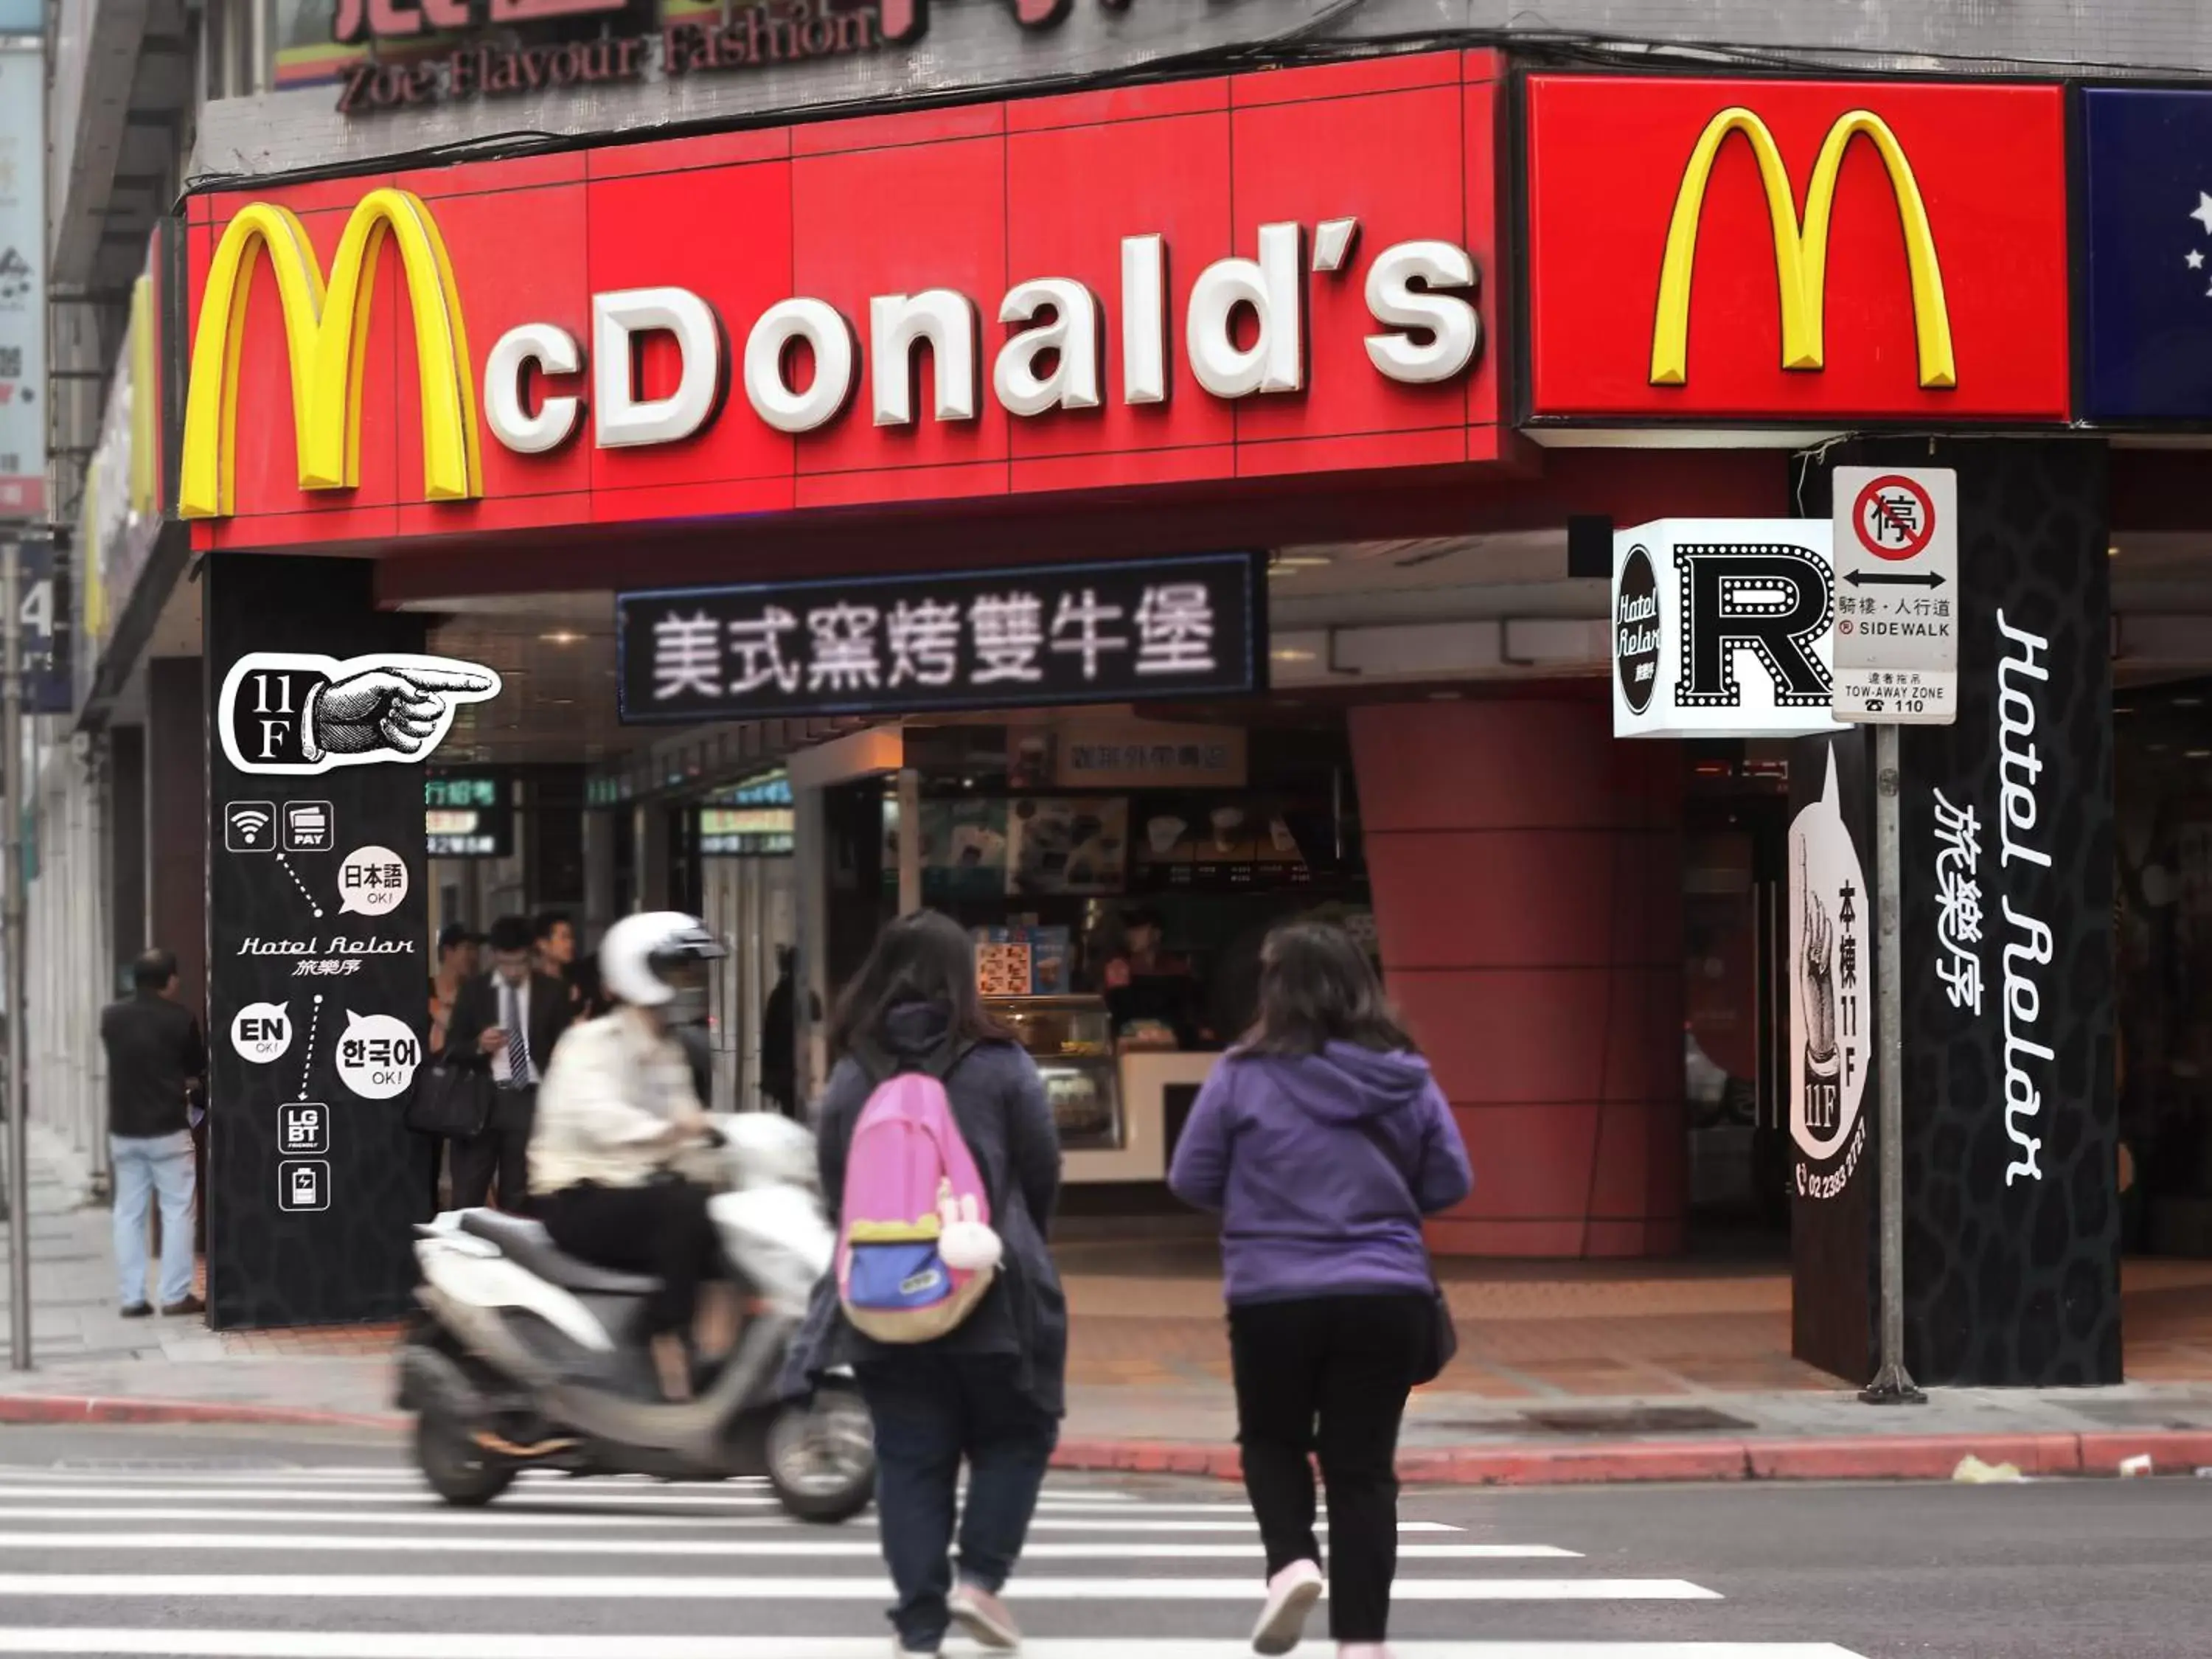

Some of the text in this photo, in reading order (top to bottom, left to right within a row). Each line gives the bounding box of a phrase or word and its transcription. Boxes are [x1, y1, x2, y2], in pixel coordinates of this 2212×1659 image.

[335, 62, 429, 113] Zoe
[447, 34, 639, 96] Flavour
[662, 6, 874, 72] Fashion
[1870, 494, 1916, 543] 停
[1617, 588, 1658, 625] Hotel
[1673, 543, 1834, 707] R
[1860, 622, 1950, 637] SIDEWALK
[1617, 625, 1660, 658] Relax
[252, 675, 294, 714] 11
[1912, 686, 1944, 699] ZONE
[1895, 700, 1924, 713] 110
[258, 720, 290, 758] F
[294, 835, 323, 845] PAY
[344, 863, 403, 888] 日本語
[367, 893, 393, 905] OK!
[1933, 785, 1984, 1017] 旅樂序
[1996, 607, 2054, 1186] Hotel Relax
[237, 935, 415, 956] Hotel Relax
[240, 1018, 284, 1041] EN
[256, 1042, 279, 1054] OK!
[342, 1038, 417, 1068] 한국어
[372, 1071, 403, 1085] OK!
[1804, 1084, 1837, 1127] 11F
[1808, 1174, 1821, 1199] 02
